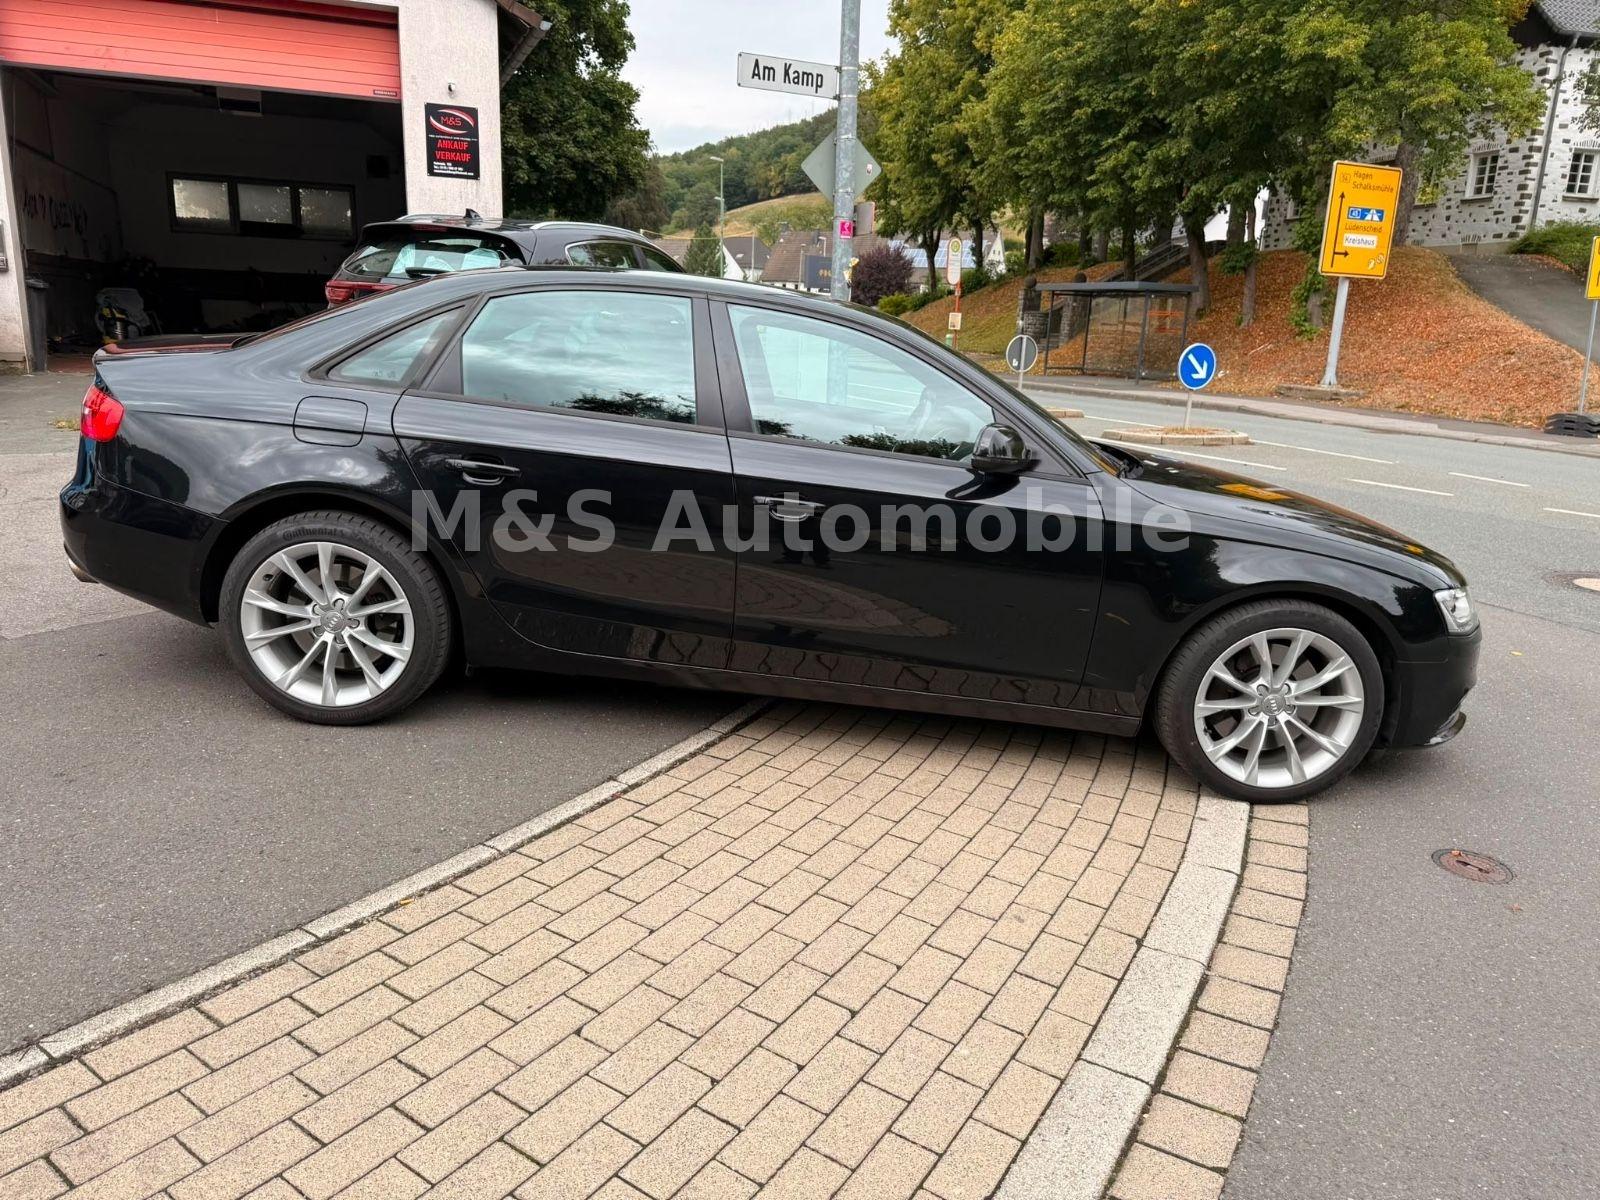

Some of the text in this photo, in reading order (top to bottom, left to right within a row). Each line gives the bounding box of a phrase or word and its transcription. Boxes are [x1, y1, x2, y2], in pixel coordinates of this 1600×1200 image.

[751, 58, 824, 94] Am Kamp
[440, 116, 462, 126] M&S
[437, 140, 469, 150] ANKAUF
[435, 151, 472, 162] VERKAUF
[1353, 170, 1373, 180] Hagen
[1352, 182, 1394, 193] Schalksmühle
[1344, 236, 1375, 246] Kreishaus
[282, 526, 337, 541] Continental
